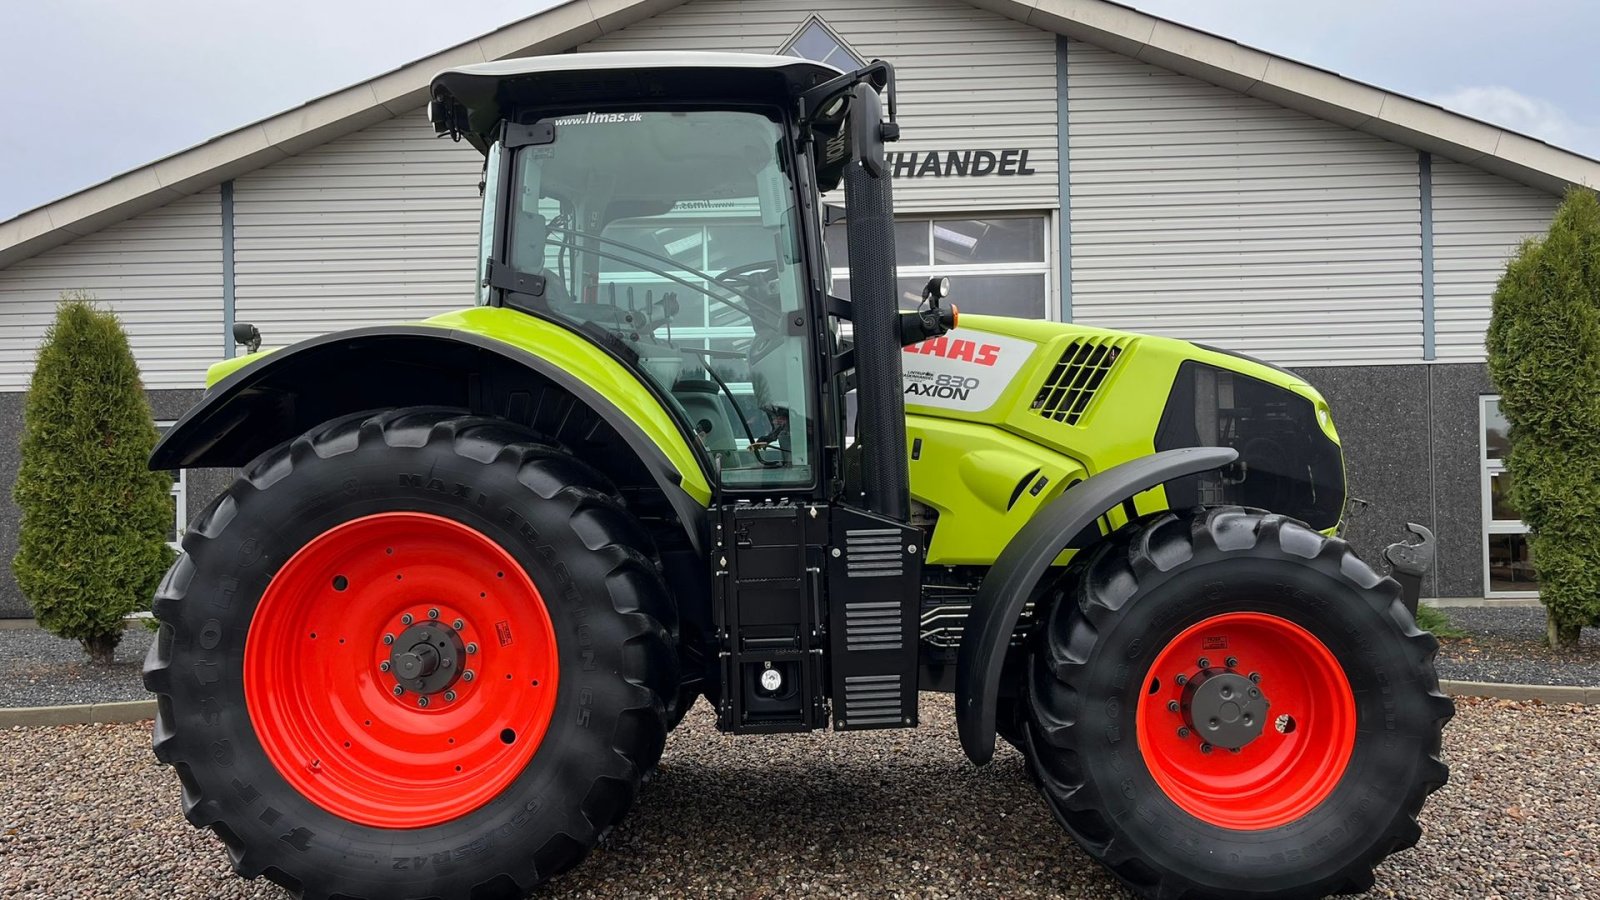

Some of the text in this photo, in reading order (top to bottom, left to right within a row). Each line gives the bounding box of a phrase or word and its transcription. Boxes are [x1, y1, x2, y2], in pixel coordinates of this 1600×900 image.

[555, 112, 642, 126] www.limas.dk
[935, 374, 980, 390] 830
[904, 382, 970, 401] AXION
